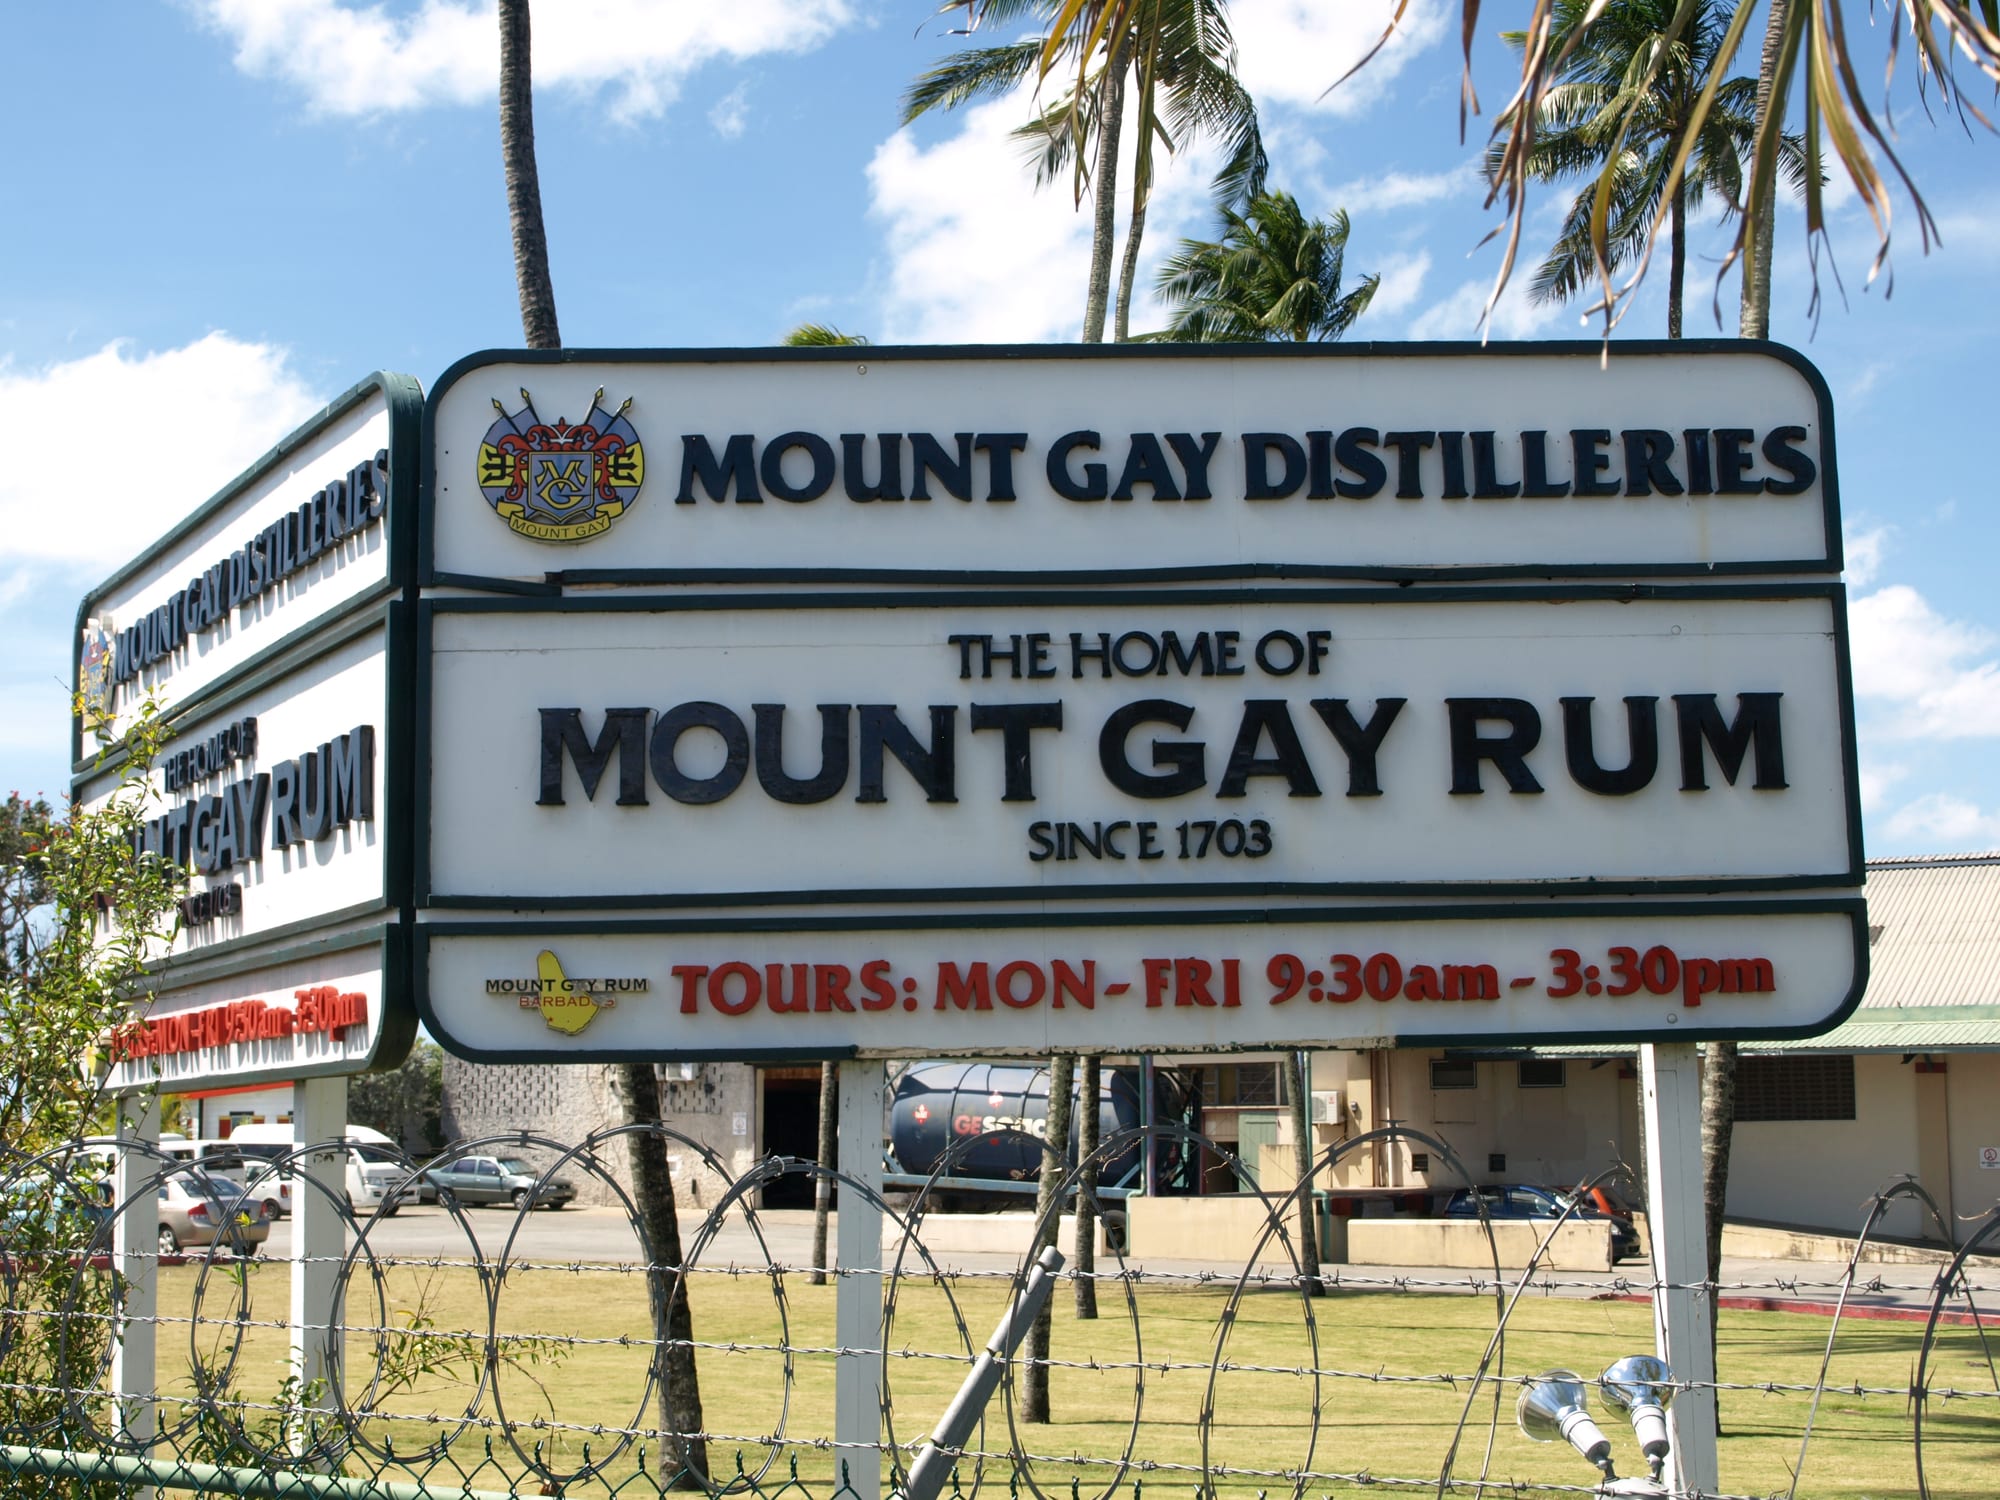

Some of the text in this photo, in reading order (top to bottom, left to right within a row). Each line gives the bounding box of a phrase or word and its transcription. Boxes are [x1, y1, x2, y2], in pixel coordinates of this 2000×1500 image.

[675, 426, 1816, 504] MOUNT GAY DISTILLERIES
[511, 519, 607, 538] MOUNT GAY
[115, 448, 388, 684] MOUNT GAY DISTILLERIES
[948, 629, 1331, 678] THE HOME OF
[535, 692, 1790, 805] MOUNT GAY RUM
[189, 773, 270, 876] GAY
[271, 724, 375, 850] RUM
[1028, 818, 1273, 861] SINCE 1703
[485, 978, 648, 993] MOUNT GY RUM
[520, 996, 615, 1008] BARBADS
[671, 959, 918, 1016] TOURS:
